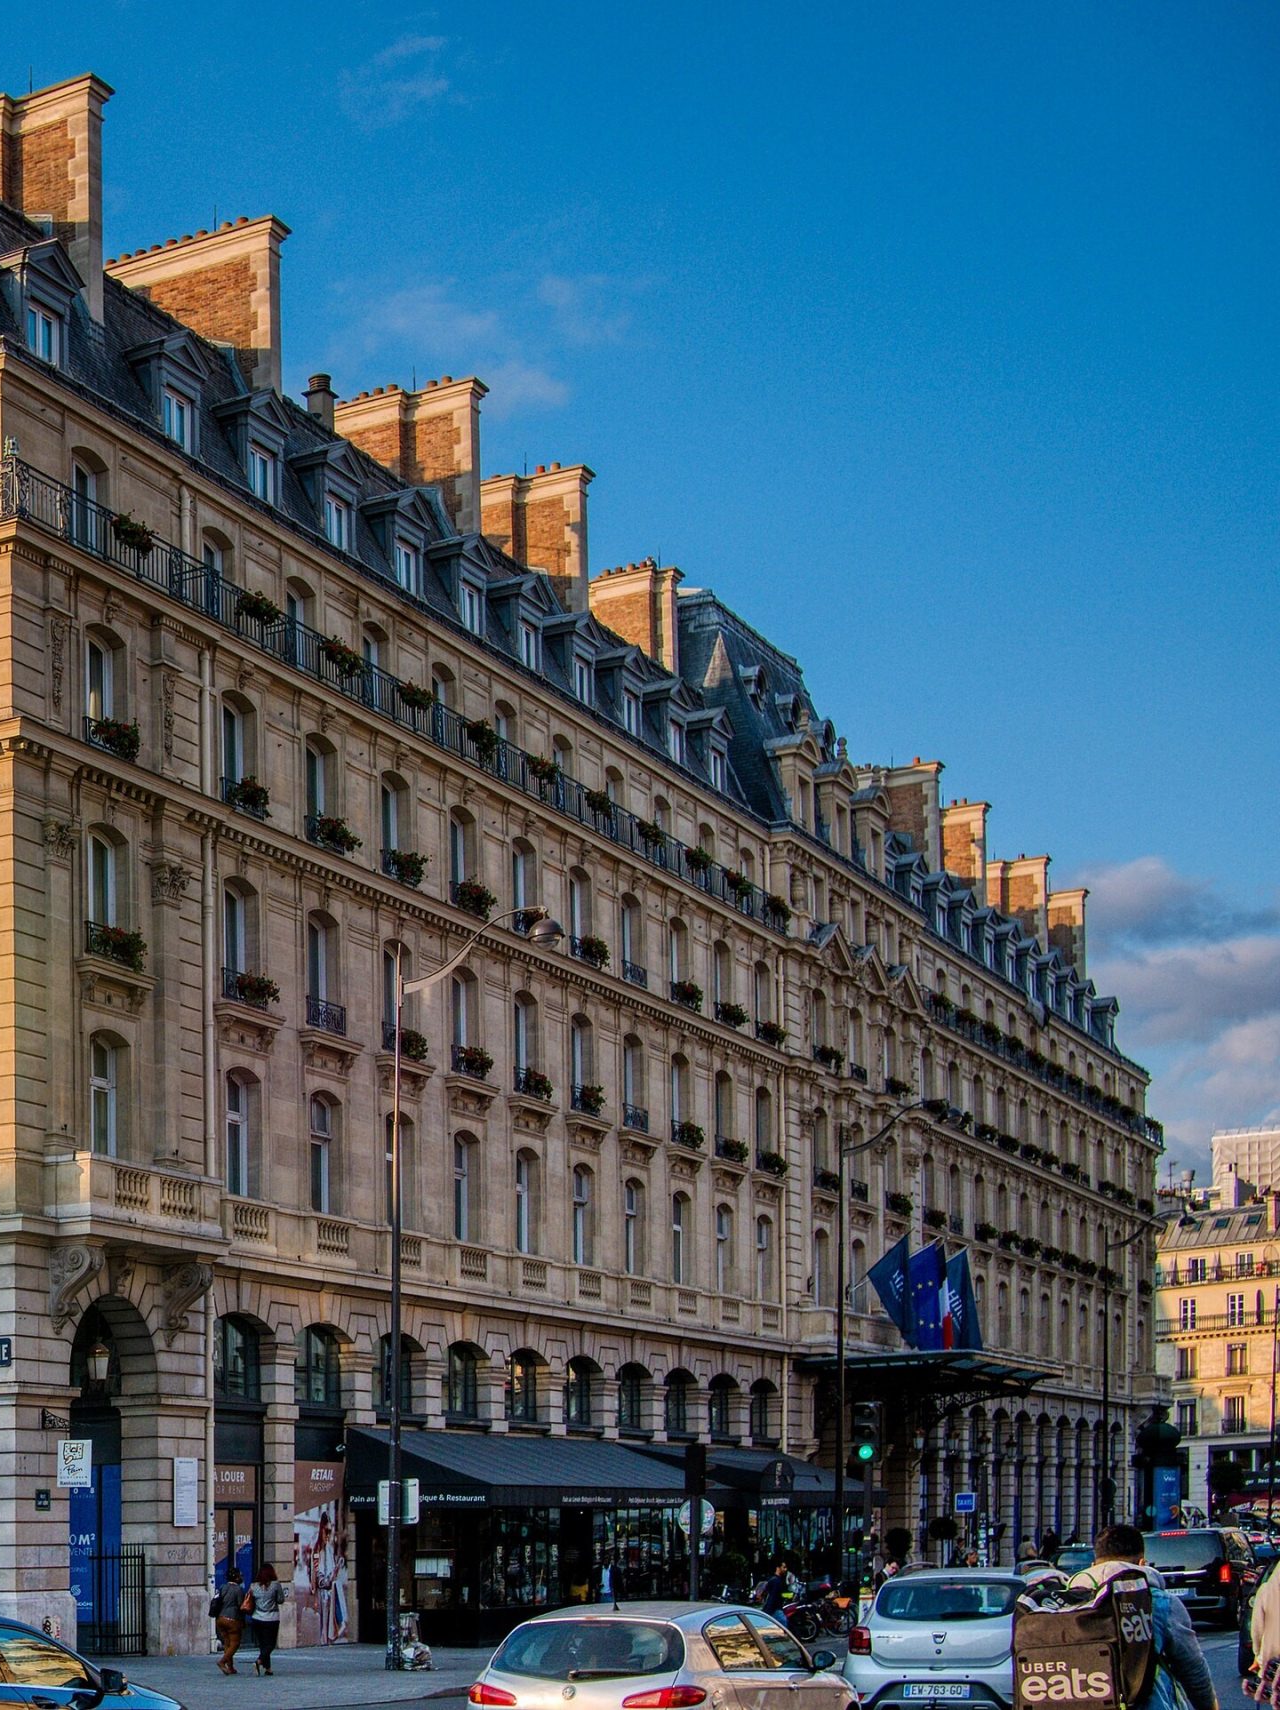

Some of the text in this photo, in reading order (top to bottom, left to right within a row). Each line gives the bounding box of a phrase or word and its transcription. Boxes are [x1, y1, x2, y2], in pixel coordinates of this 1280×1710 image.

[220, 1471, 245, 1482] LOUER
[311, 1469, 334, 1480] RETAIL
[349, 1495, 365, 1503] Pain
[439, 1493, 445, 1501] &
[446, 1494, 486, 1502] Restaurant
[1120, 1608, 1152, 1643] eat
[1021, 1661, 1068, 1674] UBER
[1021, 1667, 1111, 1702] eats
